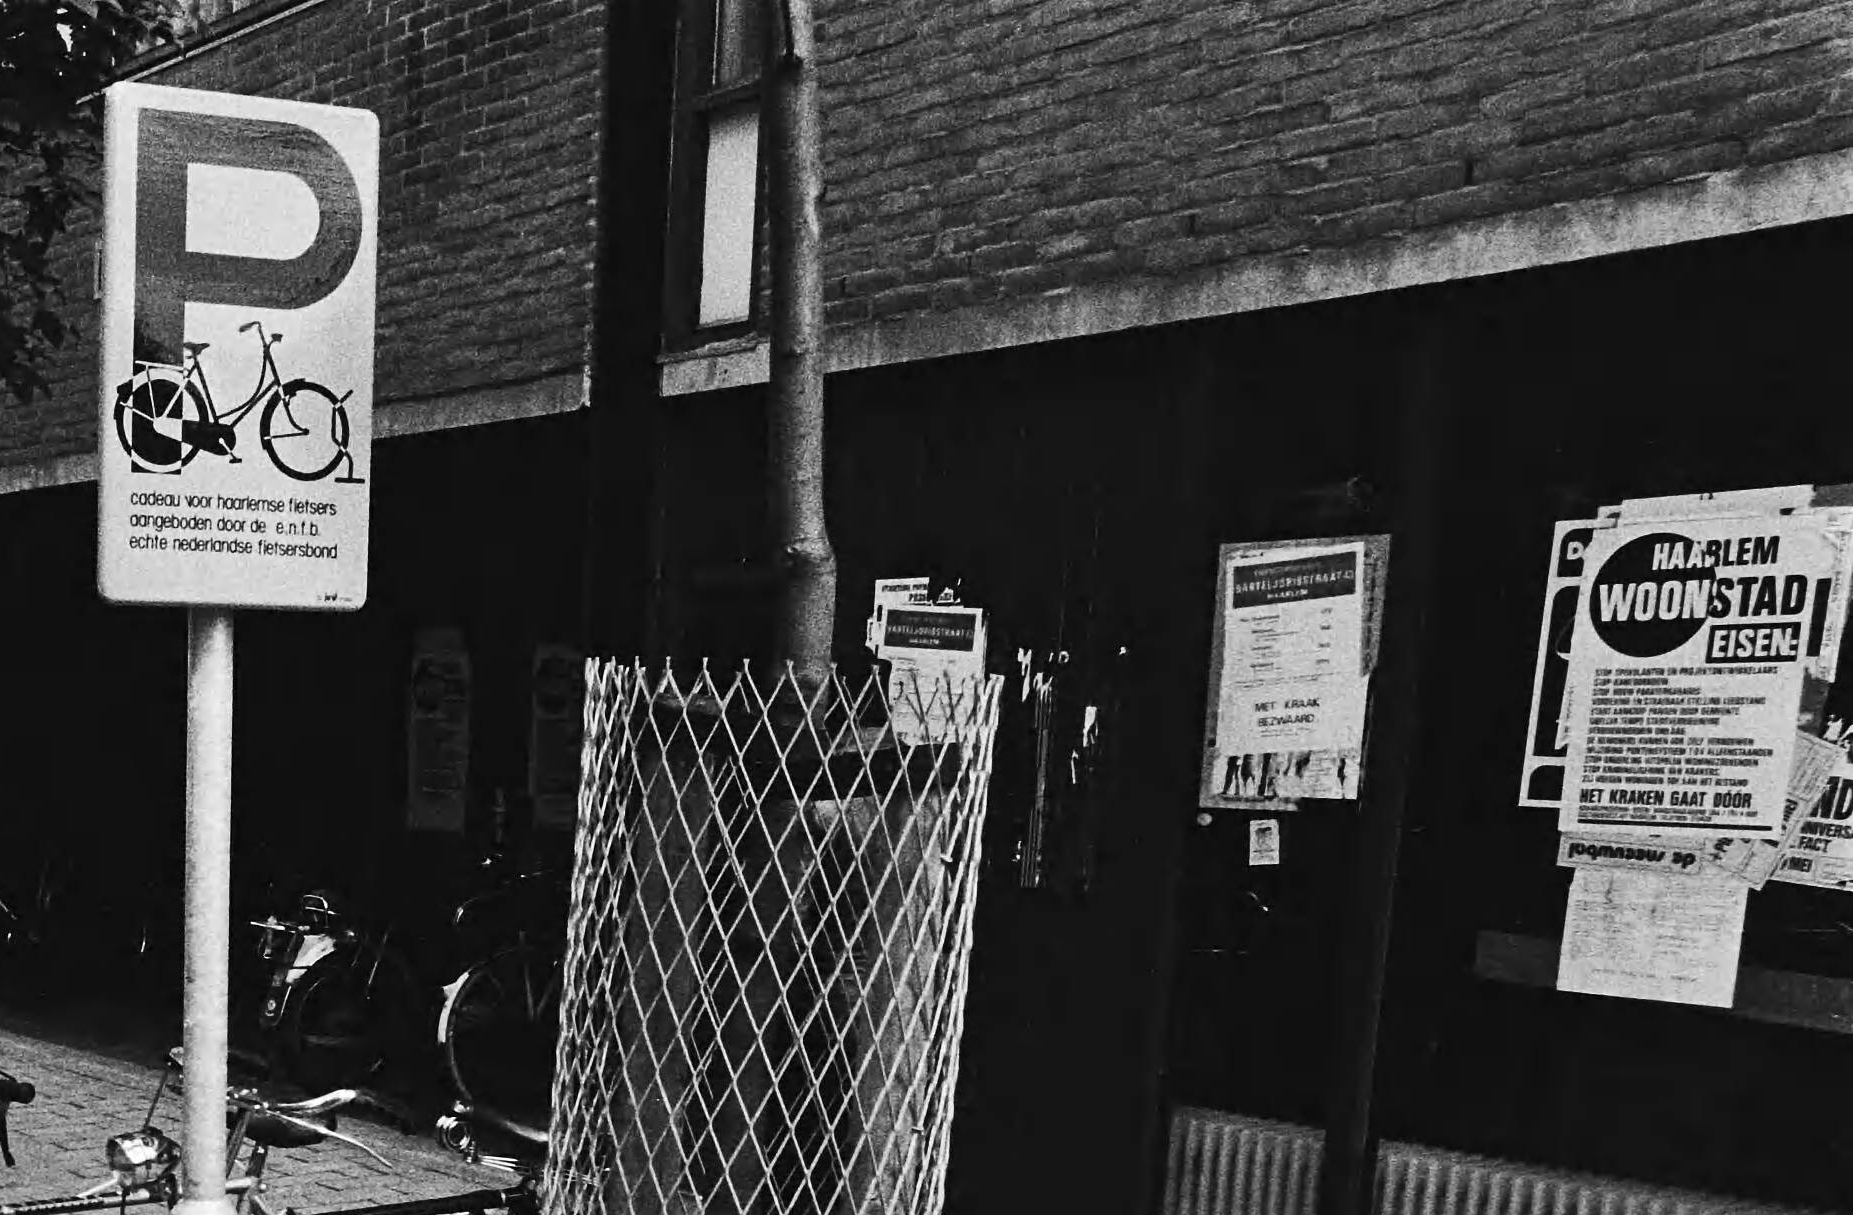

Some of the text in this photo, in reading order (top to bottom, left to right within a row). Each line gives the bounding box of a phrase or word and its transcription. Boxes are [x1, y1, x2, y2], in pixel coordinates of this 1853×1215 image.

[132, 107, 363, 475] P
[130, 492, 337, 516] cadeau voor haarlemse fietsers
[130, 514, 212, 532] aangeboden
[217, 517, 246, 532] door
[251, 518, 266, 533] de
[129, 534, 338, 559] echte nederlandse fietsersbond
[1651, 536, 1780, 570] HAARLEM
[1599, 574, 1808, 622] WOONSTAD
[1579, 789, 1604, 804] HET
[1609, 790, 1664, 805] KRAKEN
[1670, 791, 1707, 807] GAAT
